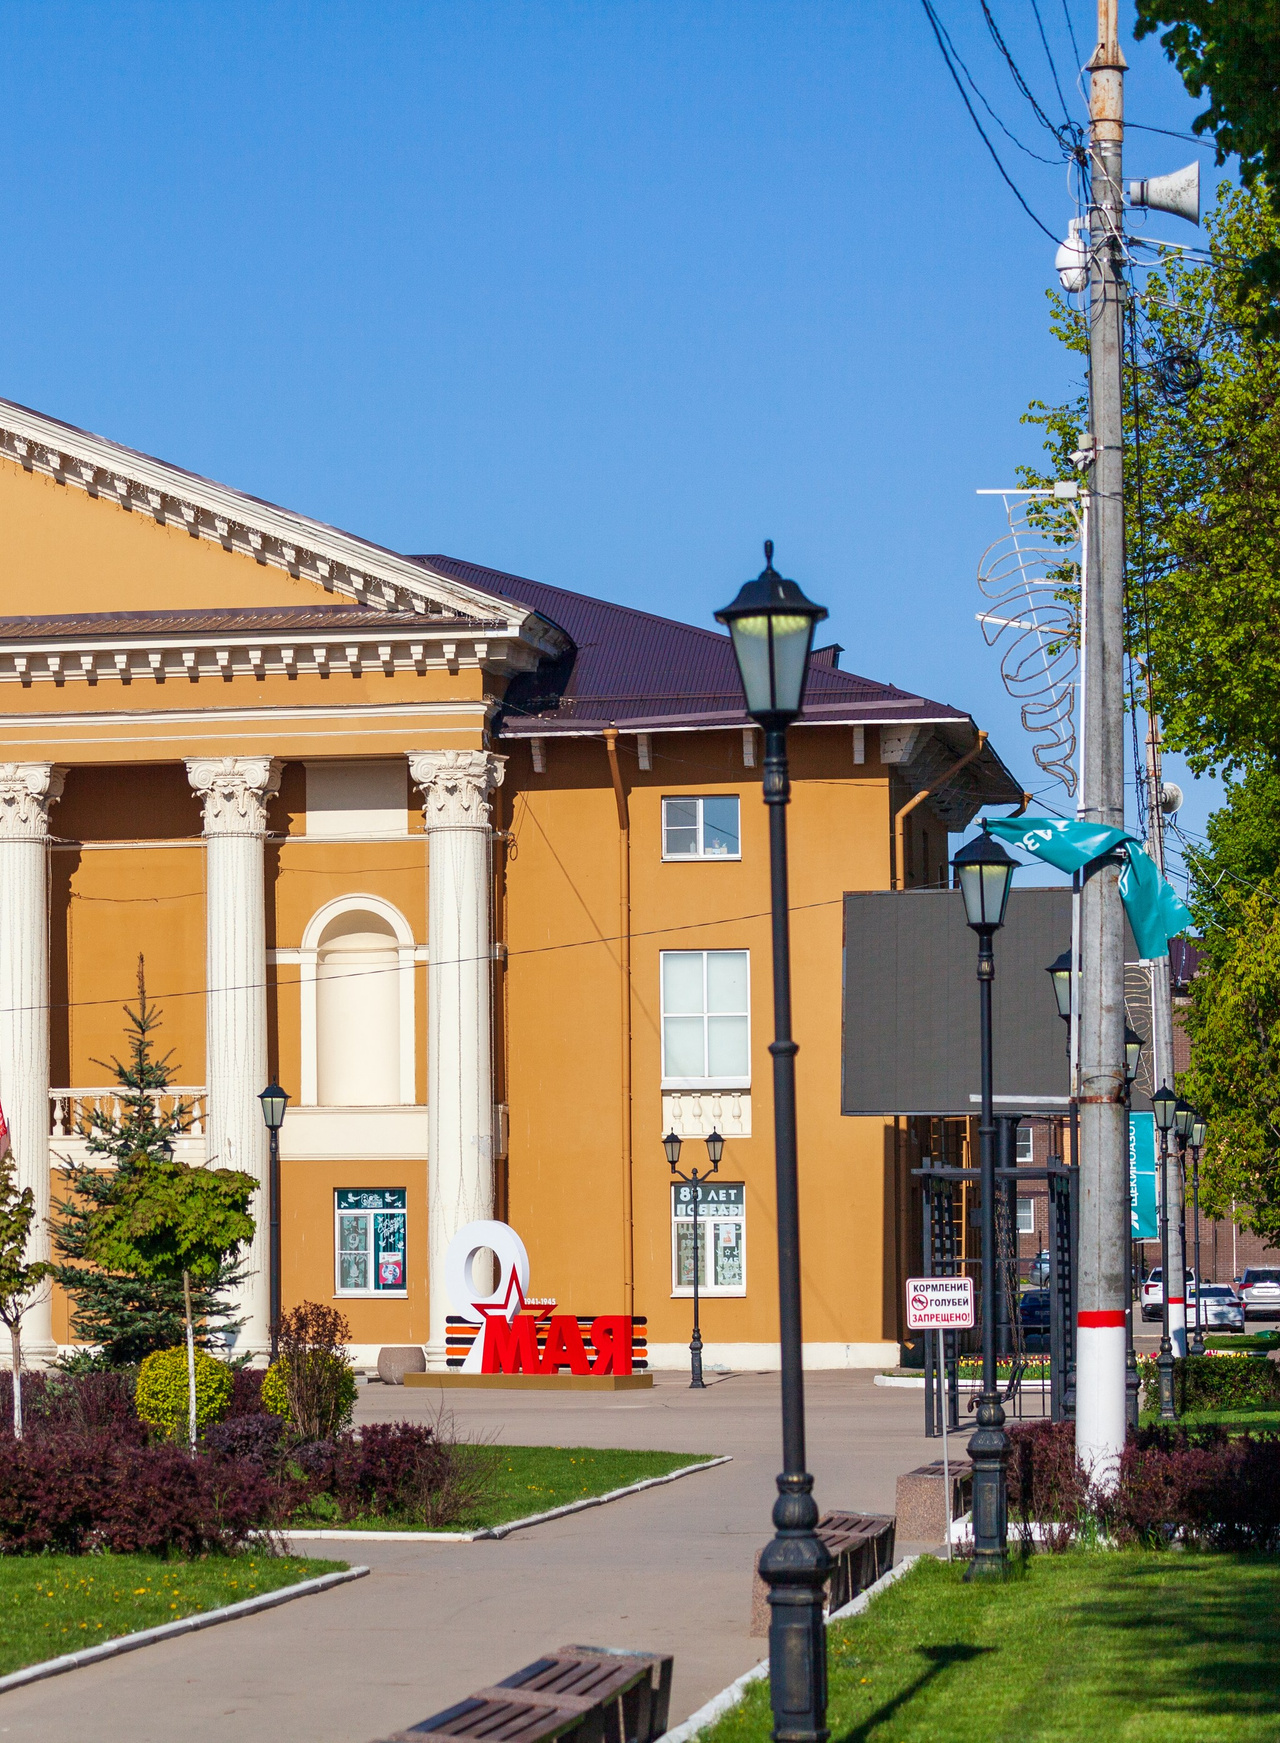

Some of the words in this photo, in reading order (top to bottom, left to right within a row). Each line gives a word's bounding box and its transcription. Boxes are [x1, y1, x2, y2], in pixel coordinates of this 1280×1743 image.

[708, 1189, 737, 1201] ЛЕТ
[676, 1204, 742, 1216] ПОБЕДЫ
[913, 1283, 968, 1292] КОРМЛЕНИЕ
[929, 1297, 969, 1306] ГОЛУБЕЙ
[912, 1313, 970, 1323] ЗАПРЕЩЕНО!
[480, 1314, 632, 1375] МАЯ
